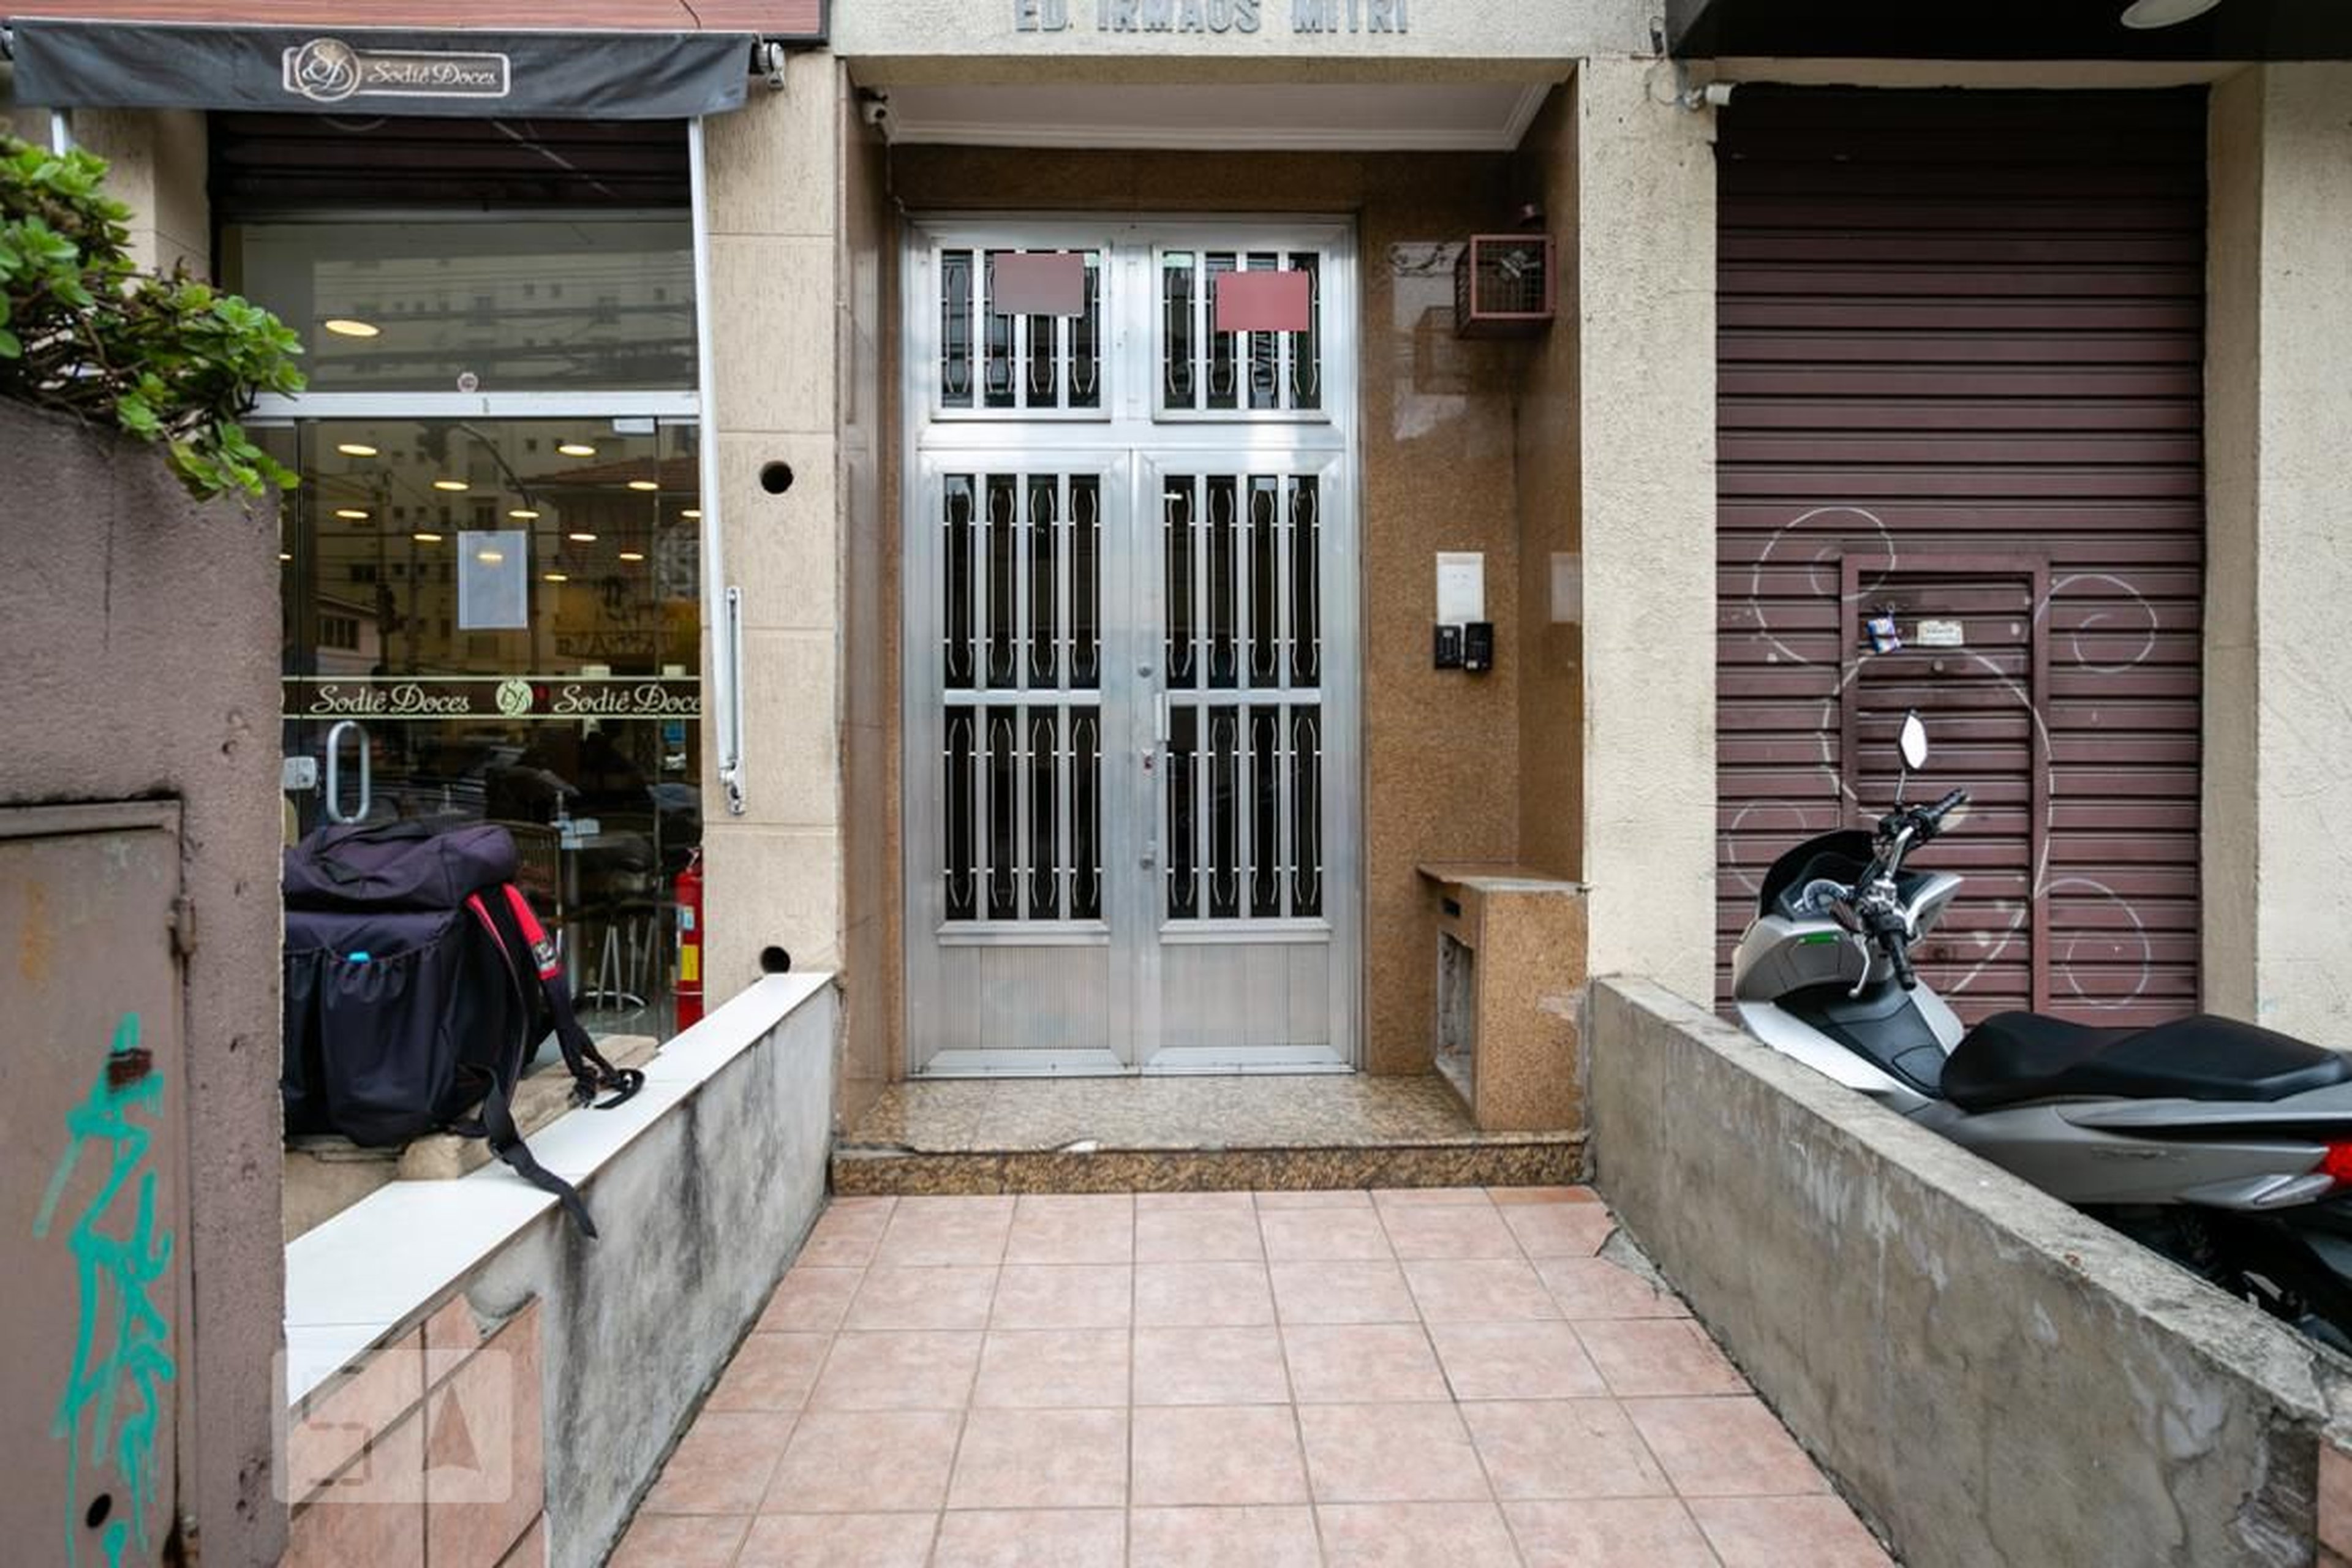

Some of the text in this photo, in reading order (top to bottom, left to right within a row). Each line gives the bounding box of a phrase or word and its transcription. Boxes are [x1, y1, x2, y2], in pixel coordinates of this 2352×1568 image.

[1015, 0, 1074, 32] ED.
[431, 62, 497, 85] Doces
[310, 684, 388, 714] Sodiê
[389, 683, 470, 713] Doces
[553, 684, 630, 714] Sodiê
